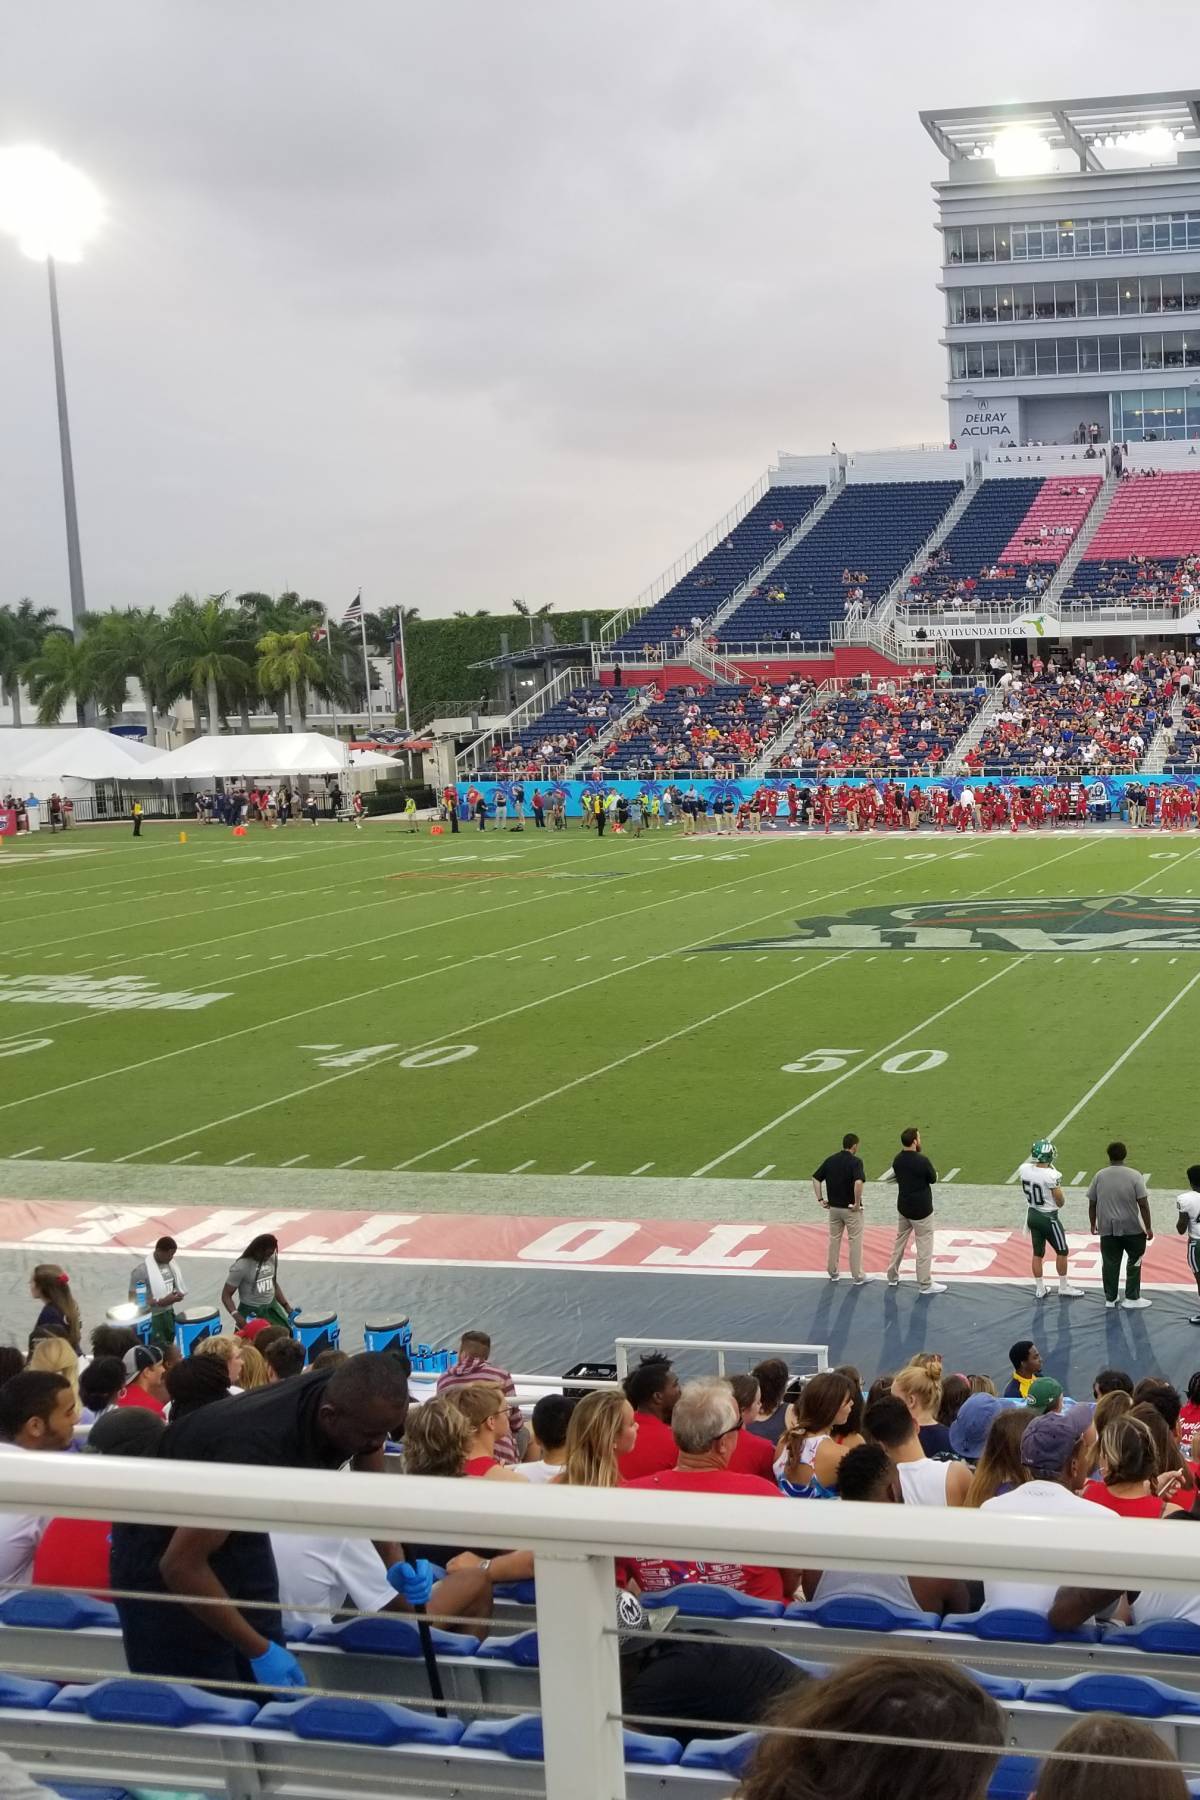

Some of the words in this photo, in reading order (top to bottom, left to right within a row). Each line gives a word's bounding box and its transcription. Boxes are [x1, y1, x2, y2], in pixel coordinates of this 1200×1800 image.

[965, 412, 1008, 423] DELRAY
[960, 425, 1011, 437] ACURA
[950, 627, 998, 637] HYUNDAI
[1000, 626, 1027, 635] DECK
[312, 1043, 480, 1068] 40
[780, 1048, 950, 1074] 50
[1022, 1180, 1046, 1206] 50
[22, 1205, 421, 1256] THE
[517, 1220, 770, 1268] TO
